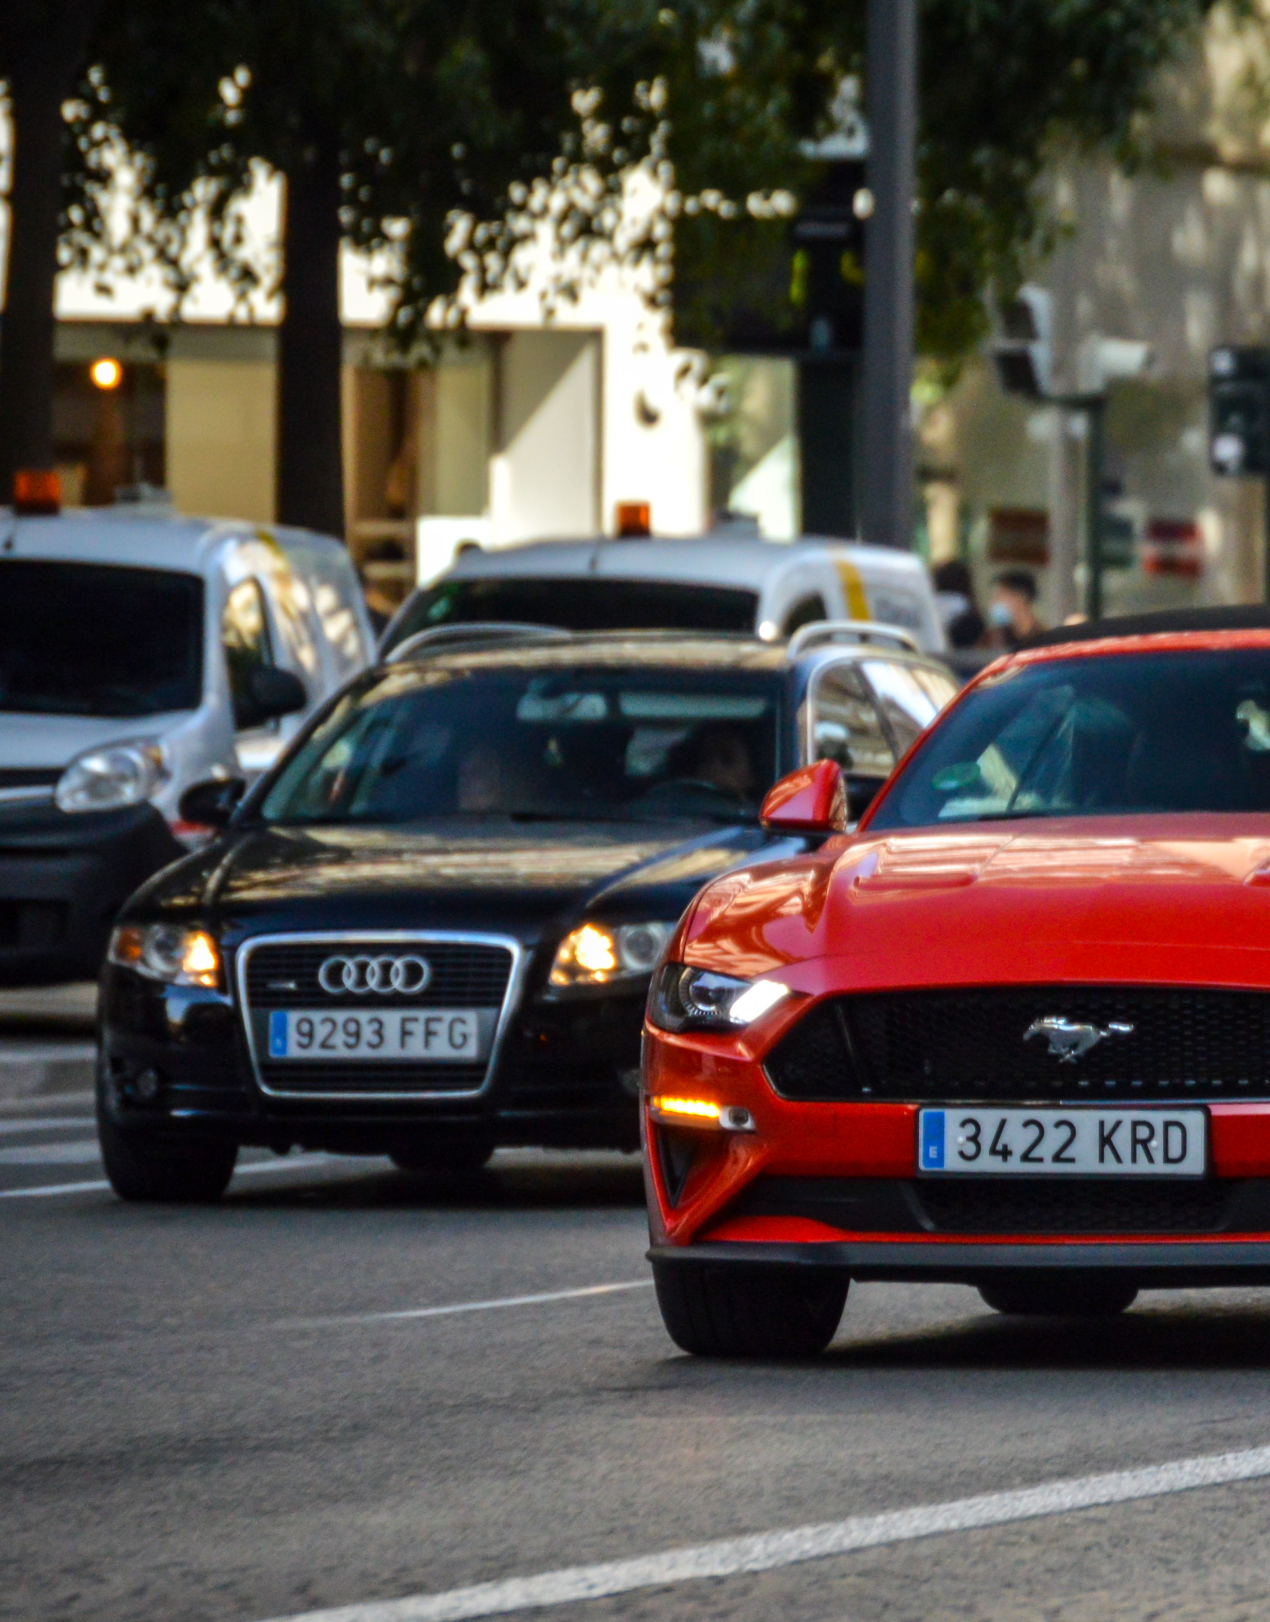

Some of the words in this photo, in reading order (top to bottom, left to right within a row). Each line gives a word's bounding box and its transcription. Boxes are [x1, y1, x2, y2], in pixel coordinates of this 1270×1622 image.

[296, 1017, 386, 1050] 9293
[400, 1017, 468, 1050] FFG
[958, 1118, 1077, 1162] 3422
[1098, 1120, 1188, 1165] KRD
